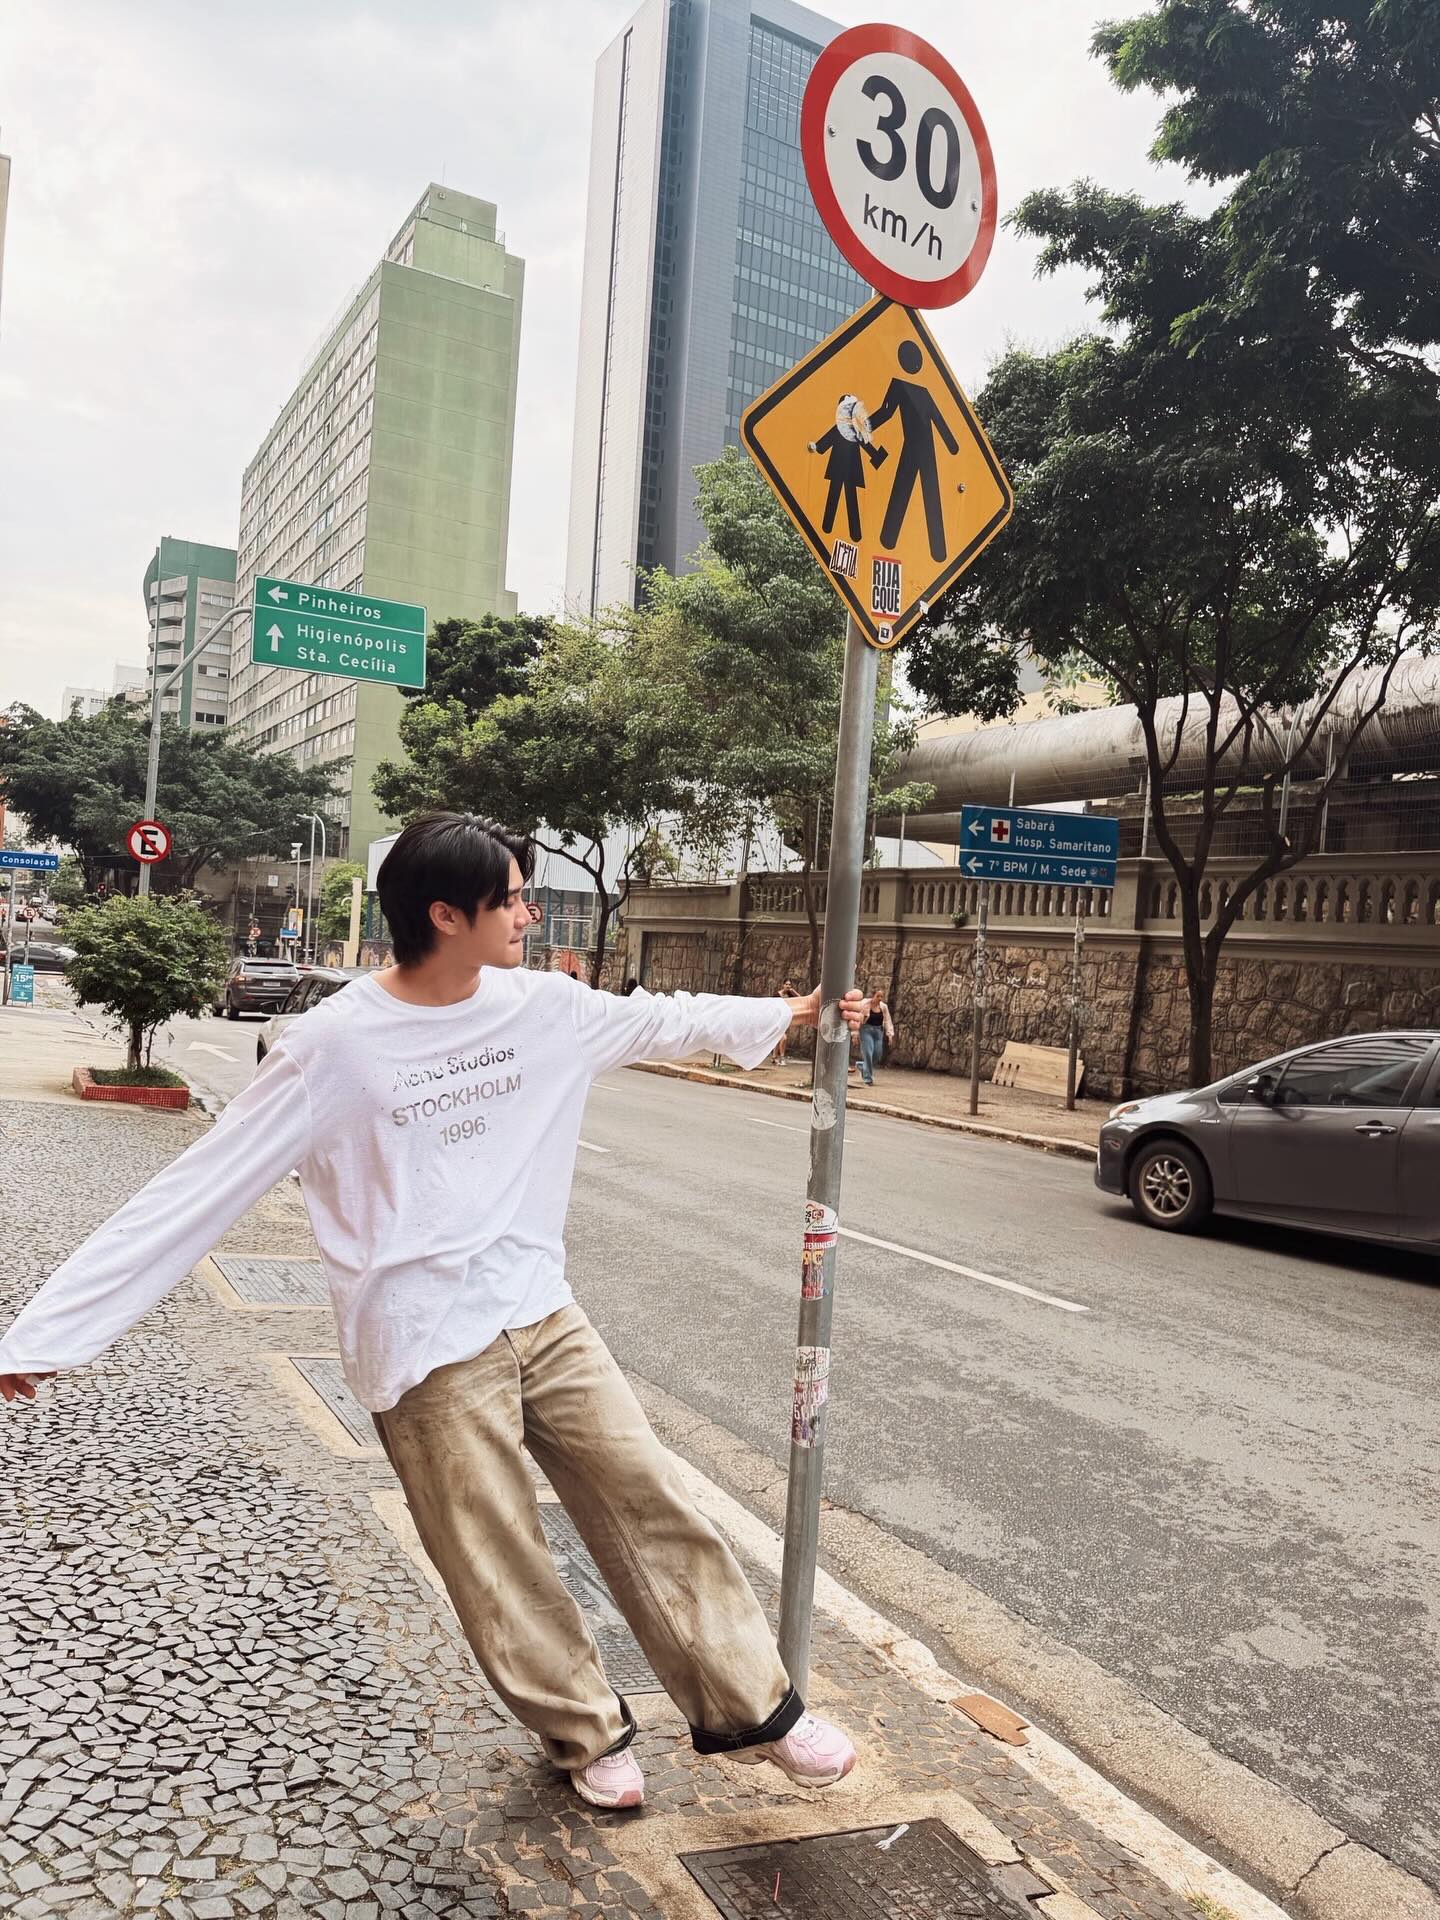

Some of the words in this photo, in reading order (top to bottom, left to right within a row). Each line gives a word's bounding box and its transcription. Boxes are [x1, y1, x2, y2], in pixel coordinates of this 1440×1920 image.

[856, 75, 960, 209] 30
[863, 193, 942, 260] km/h
[298, 593, 381, 619] Pinheiros
[297, 624, 407, 654] Higienópolis
[297, 647, 330, 664] Sta.
[339, 653, 396, 674] Cecília
[1016, 818, 1055, 832] Sabará
[1015, 836, 1045, 850] Hosp.
[1049, 839, 1111, 853] Samaritano
[2, 856, 56, 866] Consolação
[1003, 861, 1028, 873] BPM
[1031, 862, 1037, 875] /
[1040, 864, 1050, 875] M
[1060, 865, 1087, 877] Sede
[447, 1047, 515, 1075] Studios
[392, 1074, 521, 1127] STOCKHOLM
[440, 1116, 486, 1145] 1996
